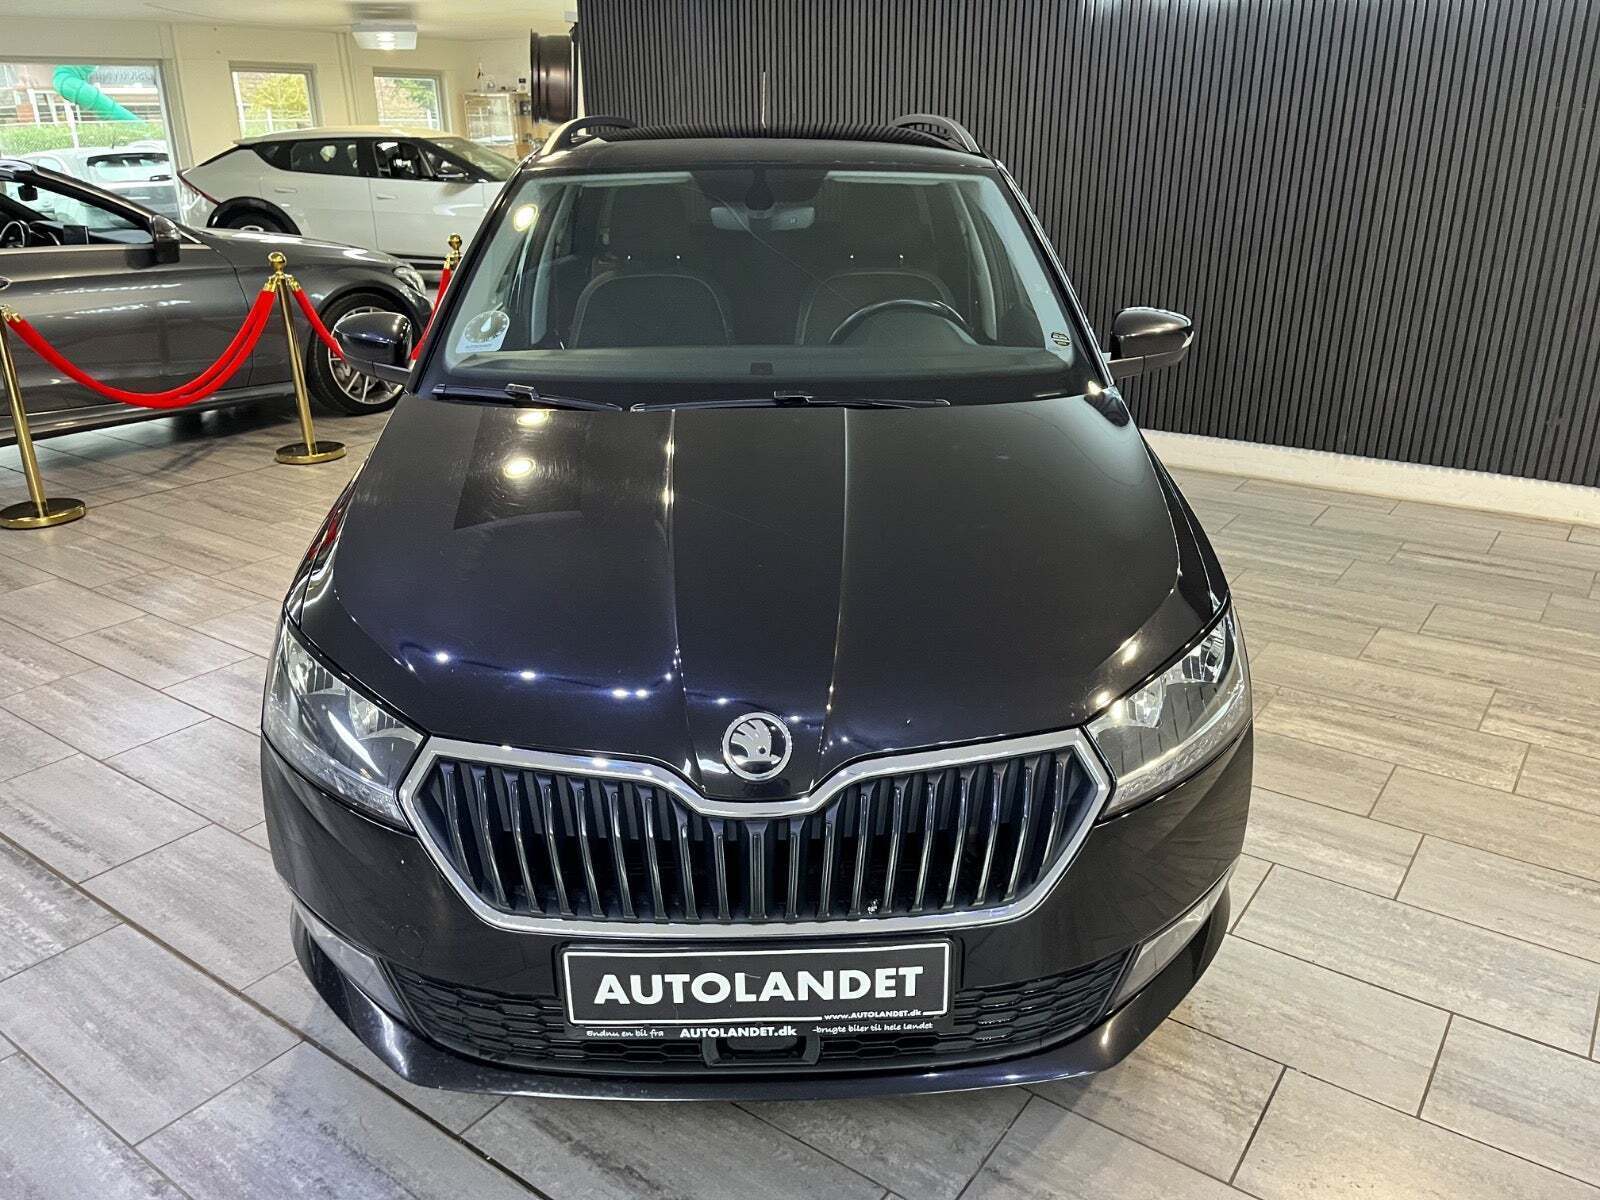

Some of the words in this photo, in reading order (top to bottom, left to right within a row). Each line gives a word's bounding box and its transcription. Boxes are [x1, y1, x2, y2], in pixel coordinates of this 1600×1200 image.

[594, 966, 923, 1004] AUTOLANDET
[824, 1009, 922, 1020] www.AUTOLANDET.dk
[635, 1028, 648, 1037] bil
[650, 1029, 664, 1038] fra
[680, 1025, 797, 1038] AUTOLANDET.dk
[848, 1024, 869, 1033] biler
[870, 1023, 882, 1032] til
[883, 1023, 901, 1031] hele
[903, 1021, 933, 1030] landet
